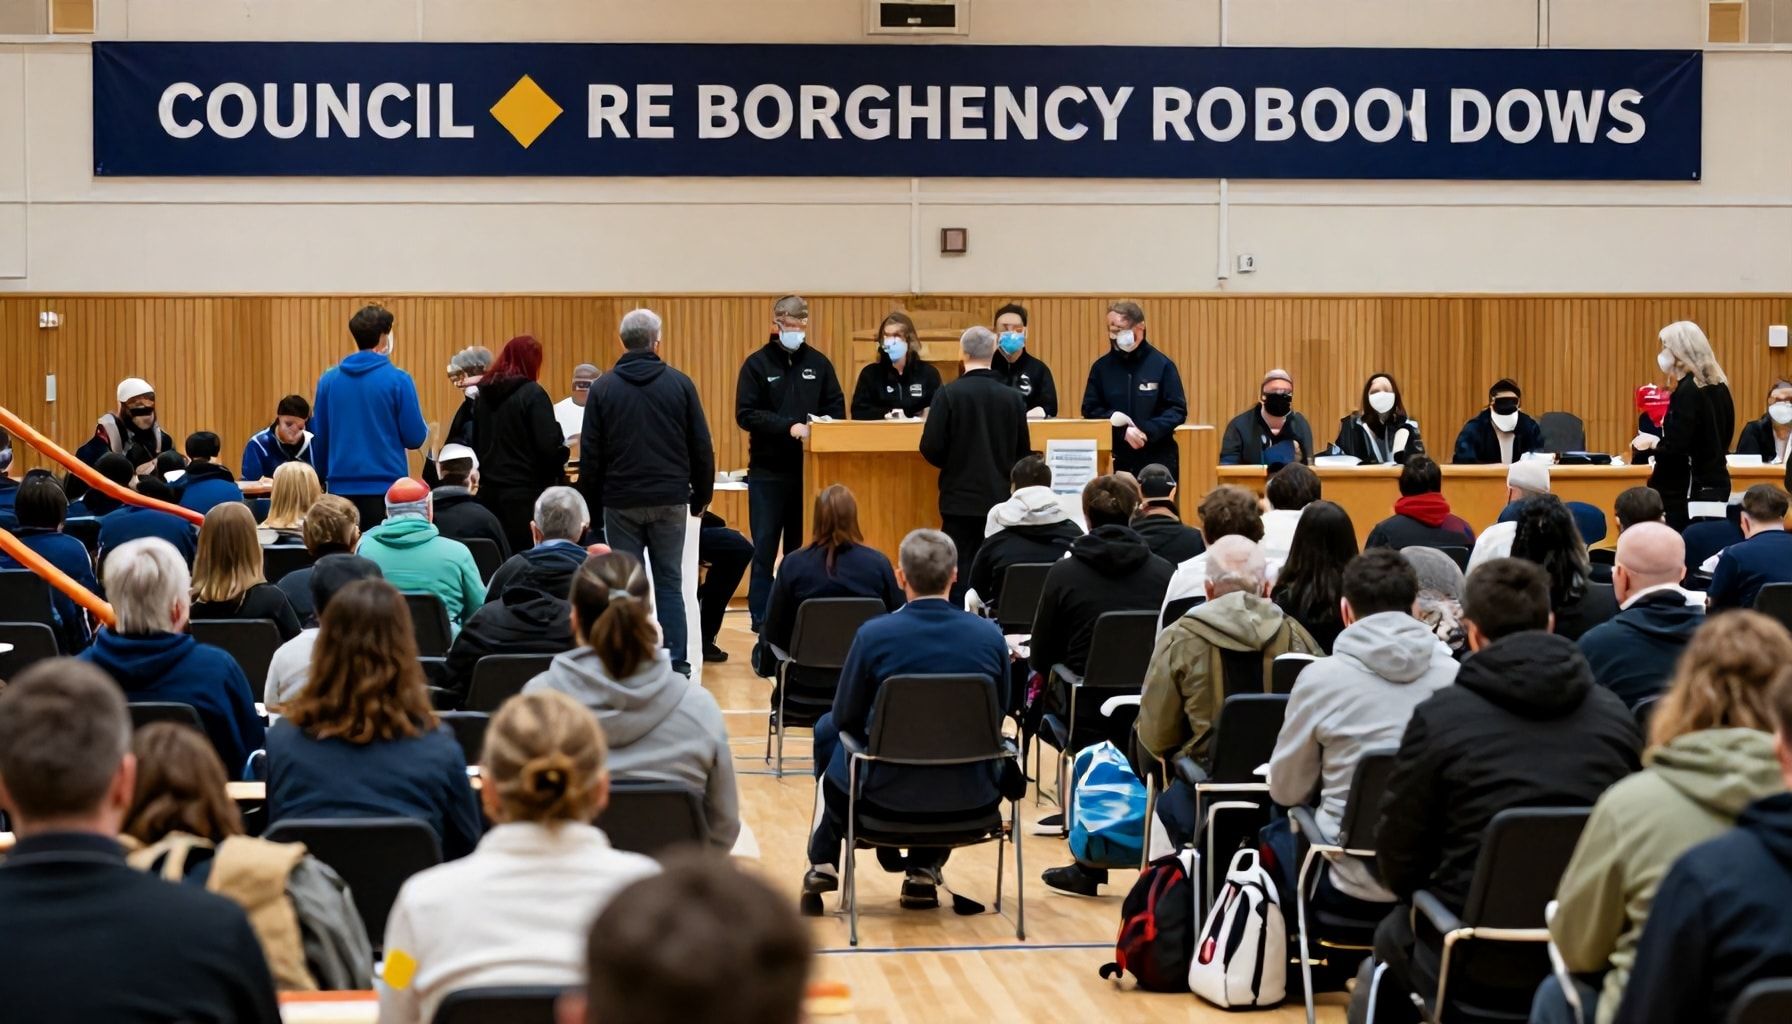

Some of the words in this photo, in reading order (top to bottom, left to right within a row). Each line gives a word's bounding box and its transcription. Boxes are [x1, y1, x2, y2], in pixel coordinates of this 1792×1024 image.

[158, 82, 475, 140] COUNCIL
[586, 84, 674, 140] RE
[698, 83, 1134, 142] BORGHENCY
[1449, 88, 1647, 145] DOWS
